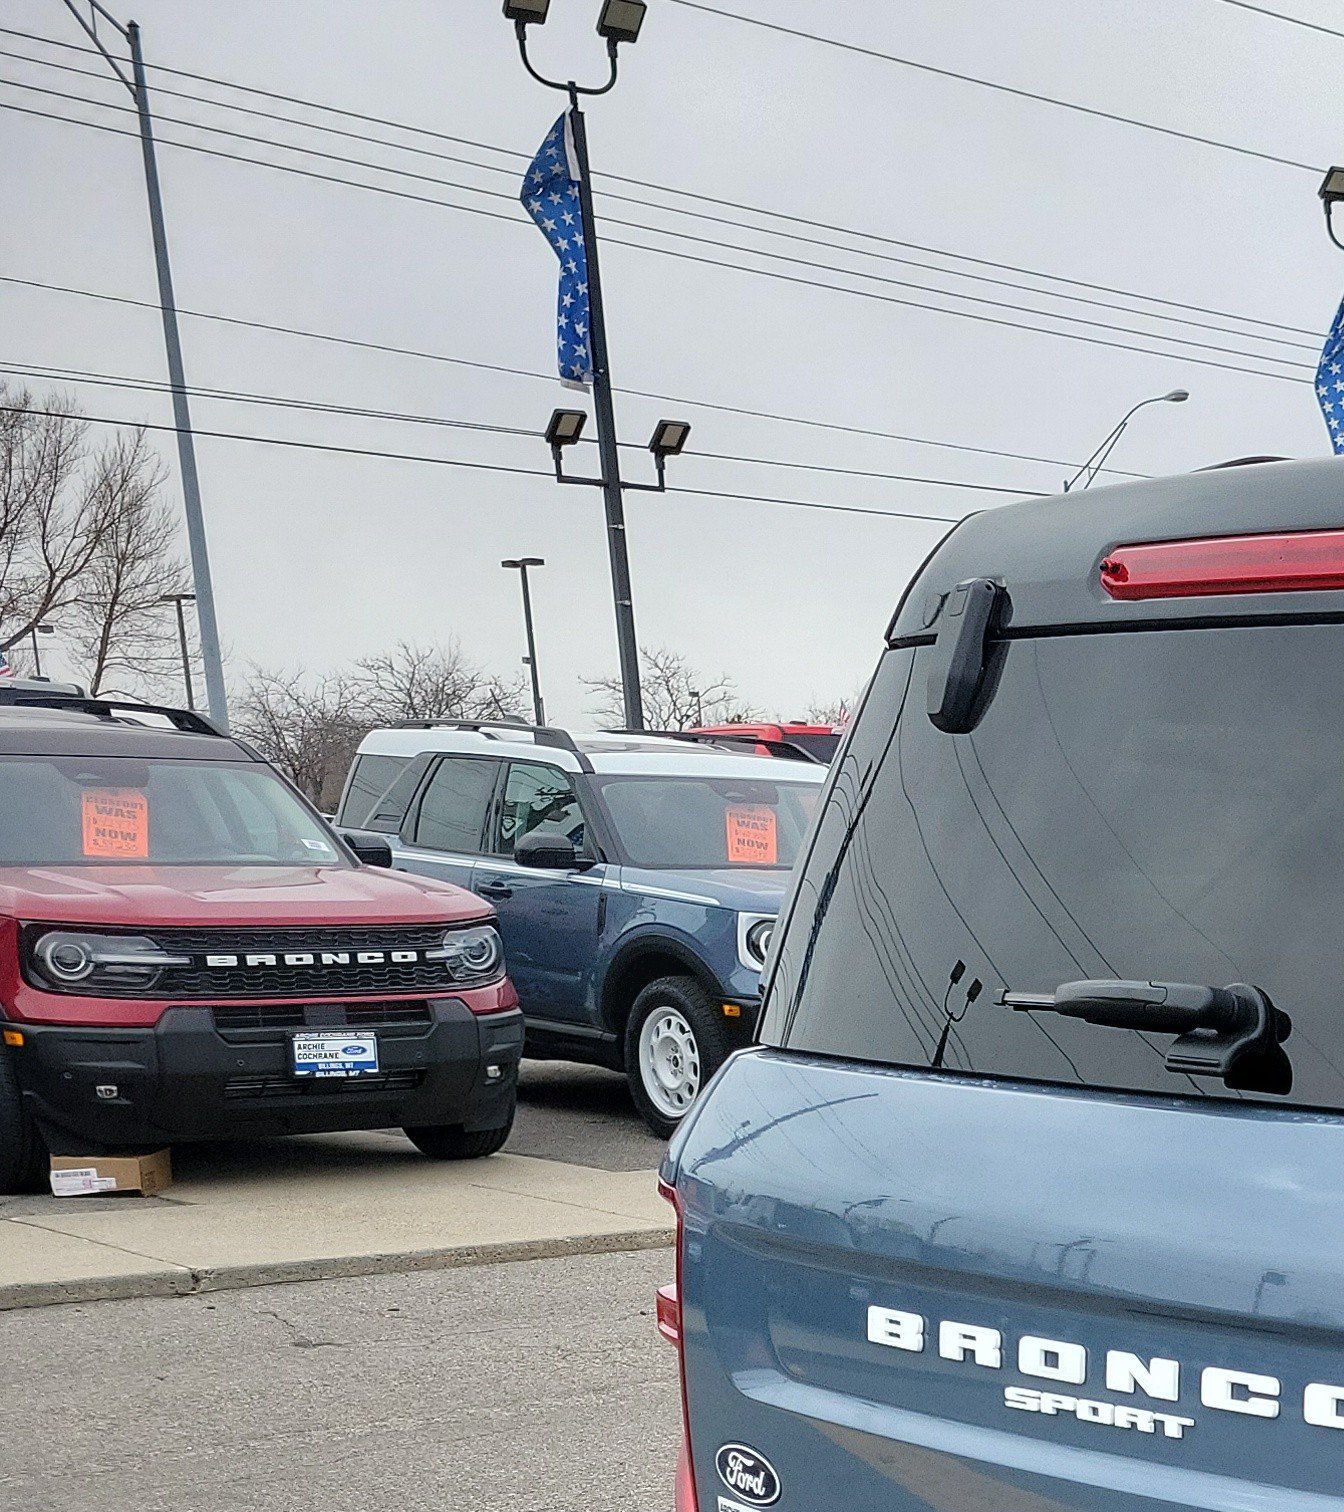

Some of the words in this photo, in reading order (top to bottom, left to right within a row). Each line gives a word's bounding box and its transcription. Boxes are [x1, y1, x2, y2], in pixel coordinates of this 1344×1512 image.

[95, 805, 137, 819] WAS
[736, 820, 768, 831] WAS
[95, 827, 137, 841] NOW
[736, 838, 769, 851] NOW
[206, 951, 418, 967] BRONCO
[297, 1043, 325, 1051] ARCHIE
[344, 1046, 364, 1054] Ford
[297, 1052, 340, 1060] COCHRANE
[1003, 1385, 1195, 1439] SPORT
[726, 1451, 766, 1496] Ford
